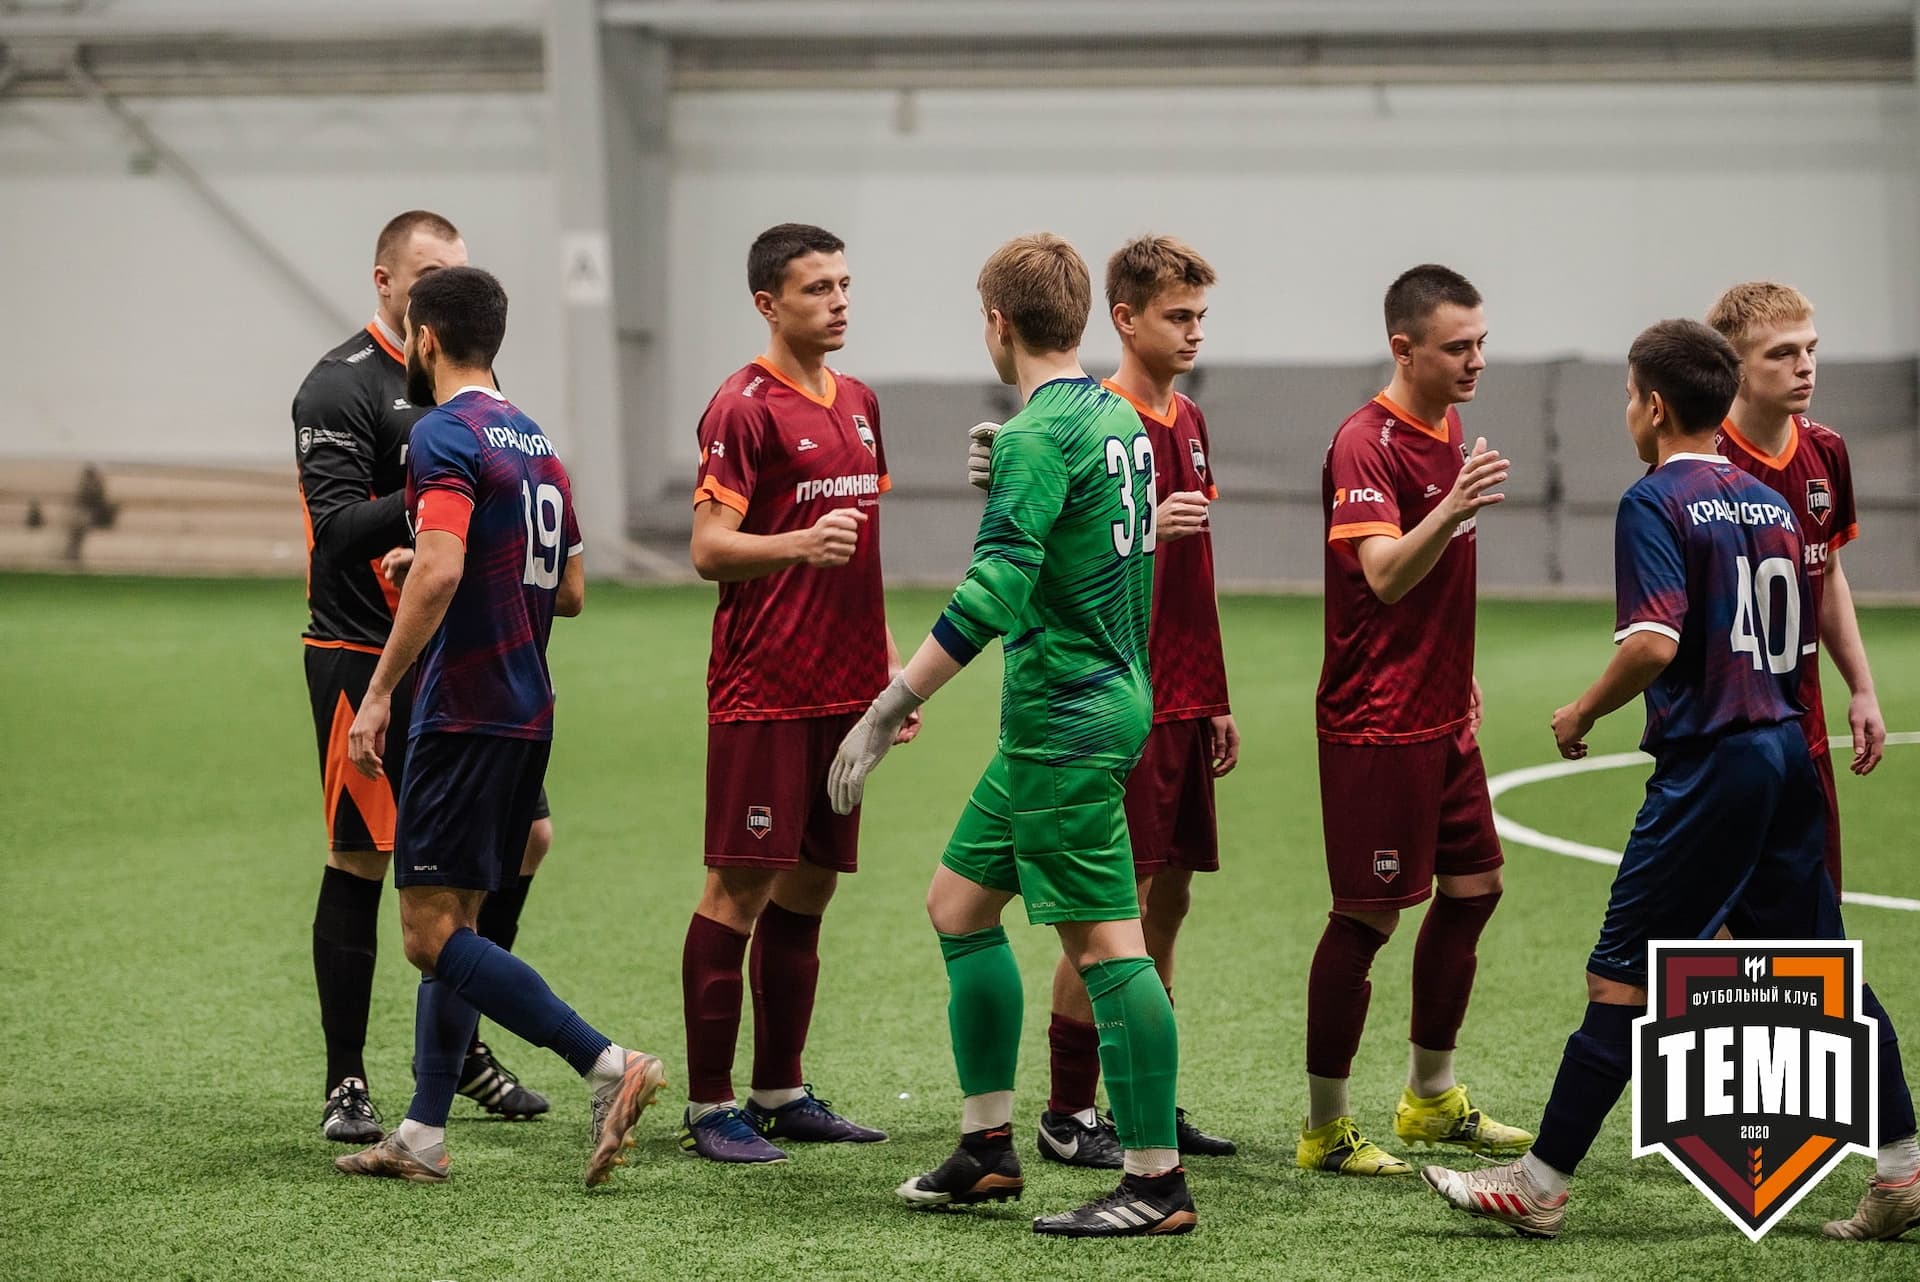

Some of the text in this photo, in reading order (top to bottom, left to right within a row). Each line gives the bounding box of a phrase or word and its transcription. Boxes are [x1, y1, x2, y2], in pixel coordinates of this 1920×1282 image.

[522, 479, 564, 589] 19
[1105, 433, 1157, 558] 33
[1686, 499, 1795, 532] КРАНОЯРСК
[1730, 555, 1801, 674] 40
